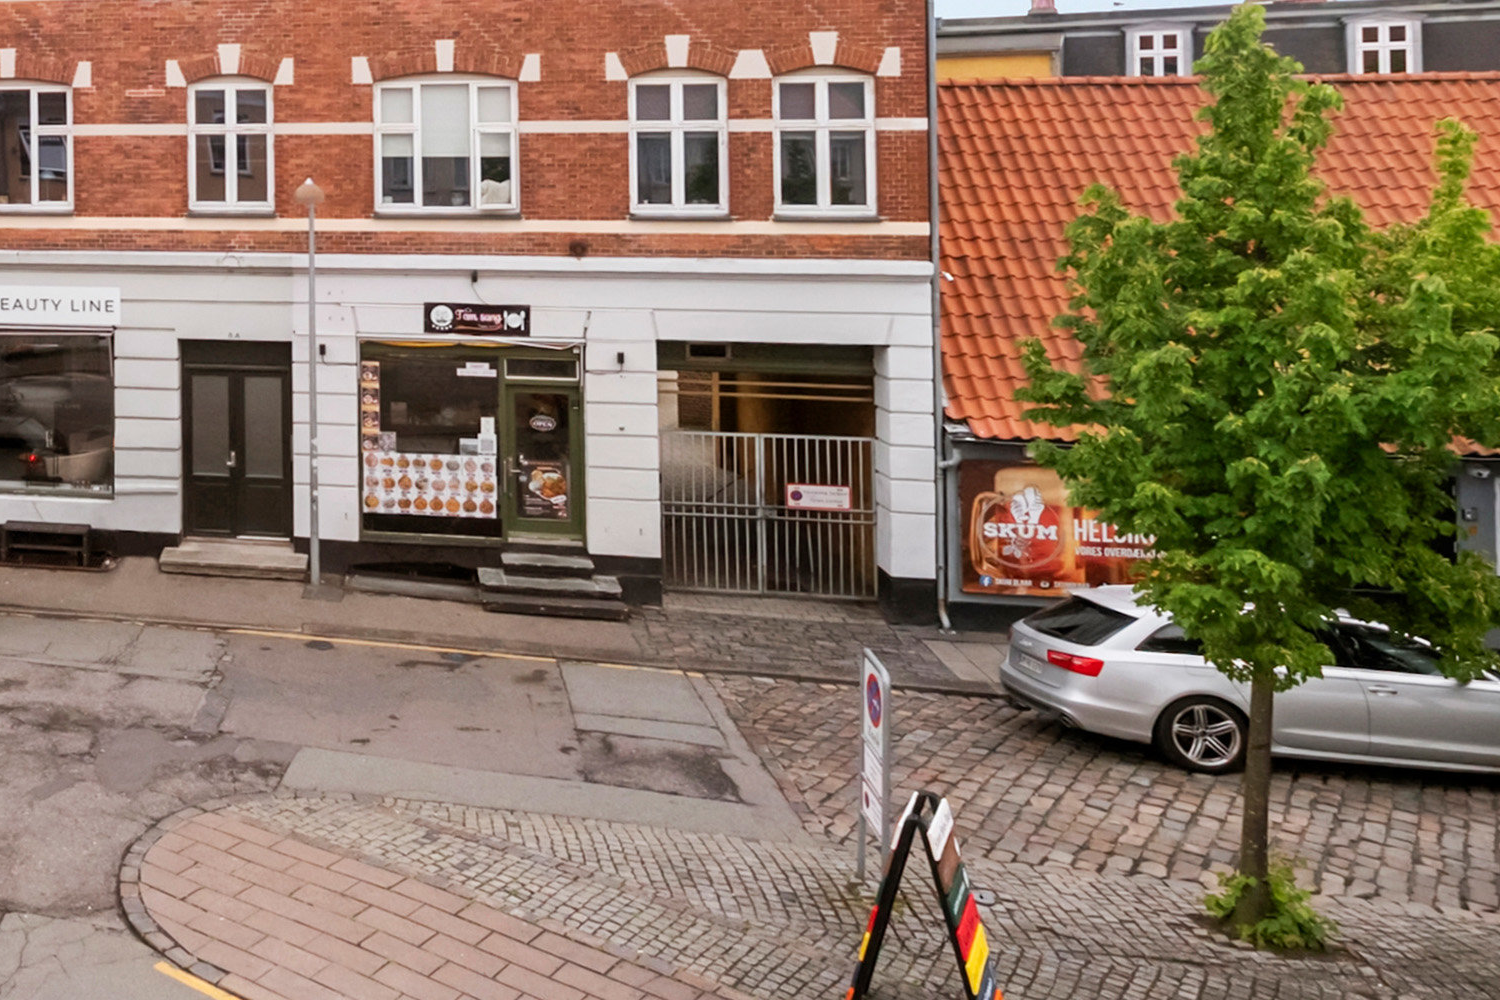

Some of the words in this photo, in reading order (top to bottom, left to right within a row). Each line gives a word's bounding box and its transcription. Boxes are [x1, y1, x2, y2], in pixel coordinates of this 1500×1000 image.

[71, 299, 115, 313] LINE
[983, 522, 1058, 541] SKUM
[1075, 546, 1102, 557] VORES
